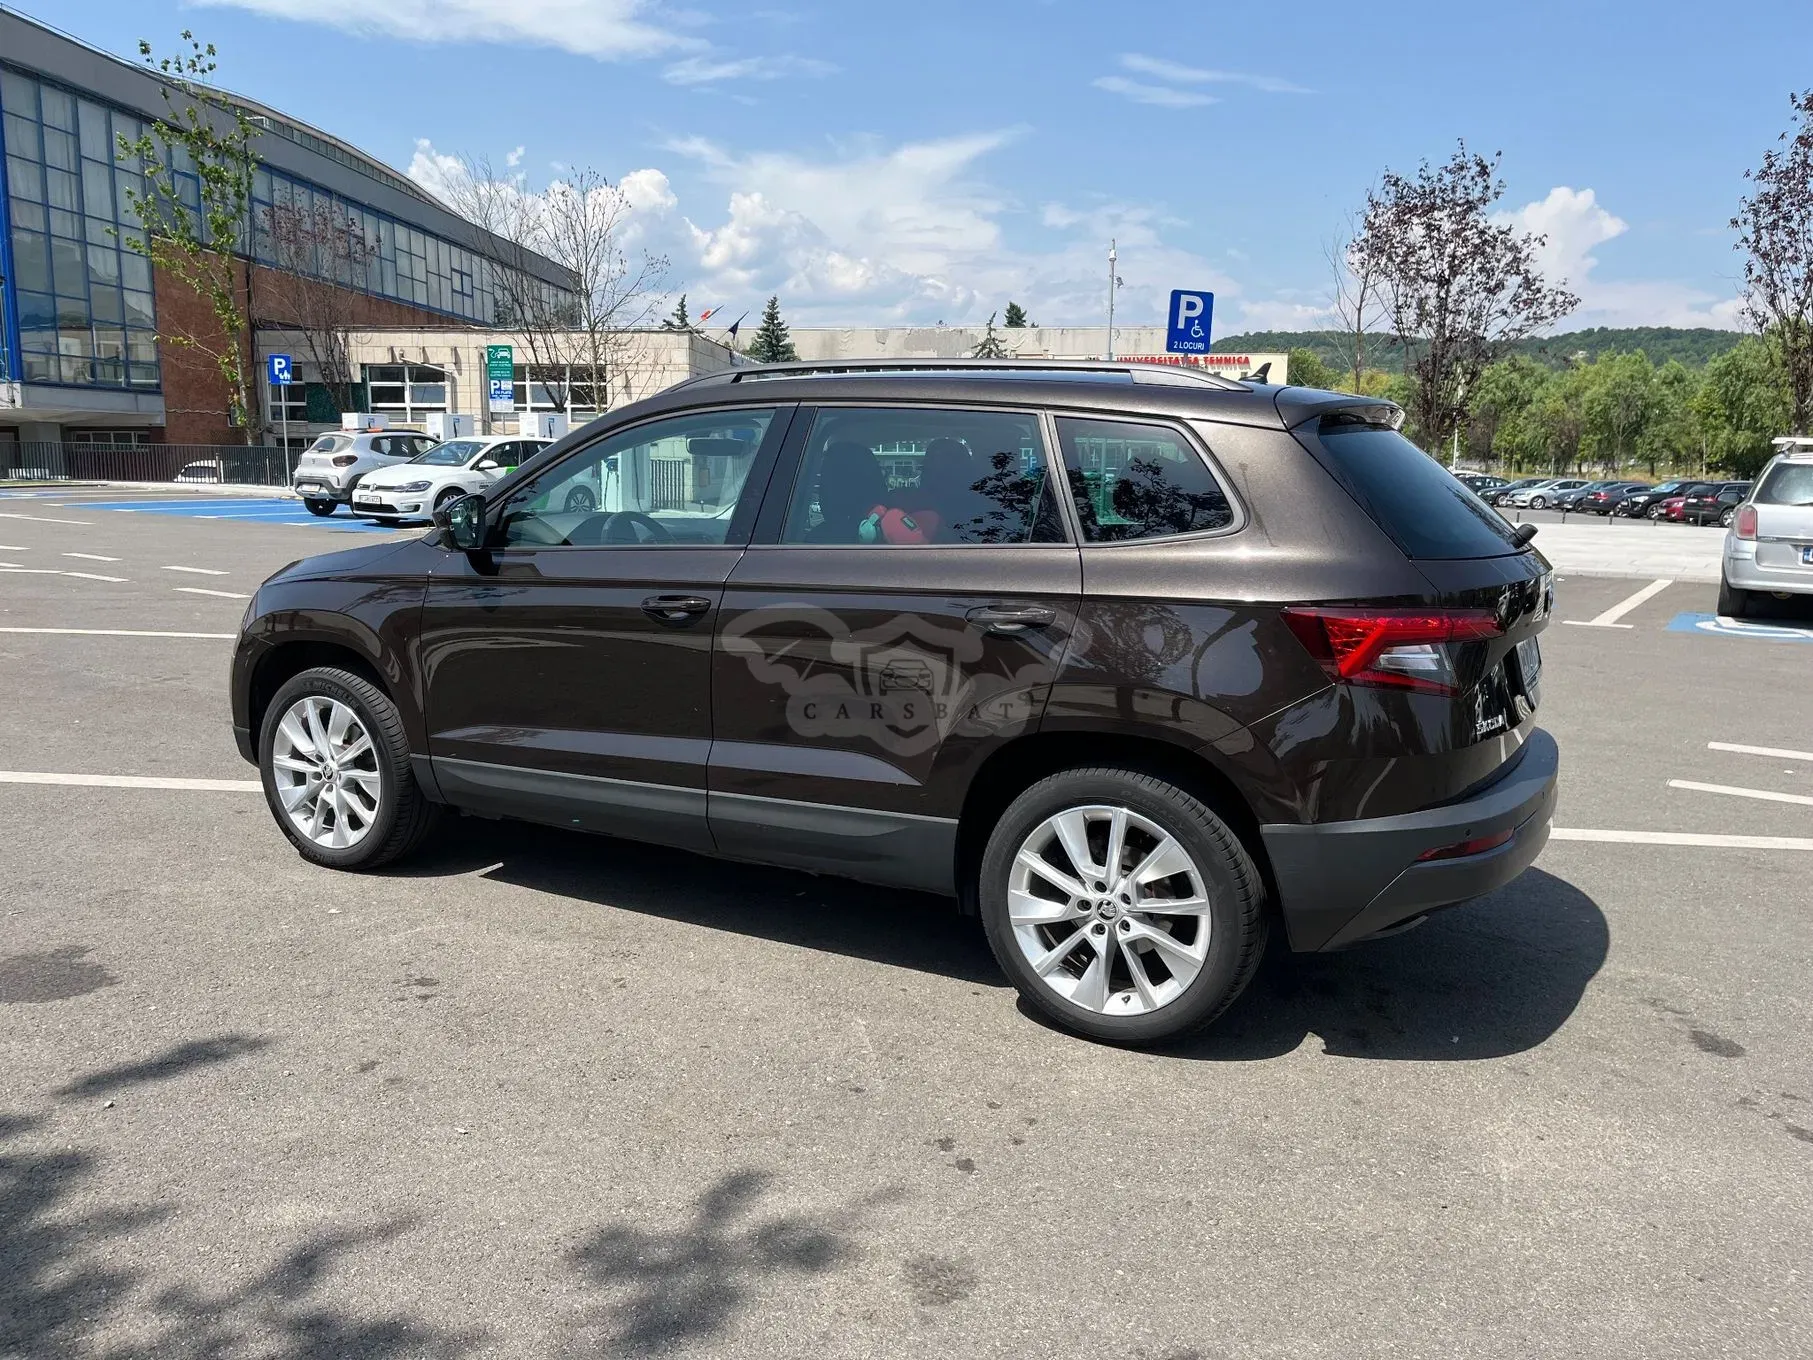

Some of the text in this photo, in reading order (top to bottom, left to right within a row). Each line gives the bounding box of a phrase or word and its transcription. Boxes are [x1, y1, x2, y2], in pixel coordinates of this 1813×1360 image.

[1177, 294, 1204, 330] P
[1173, 340, 1205, 351] 2 LOCURI
[274, 358, 286, 375] P
[1202, 356, 1250, 365] TEHNICA
[491, 380, 500, 395] P
